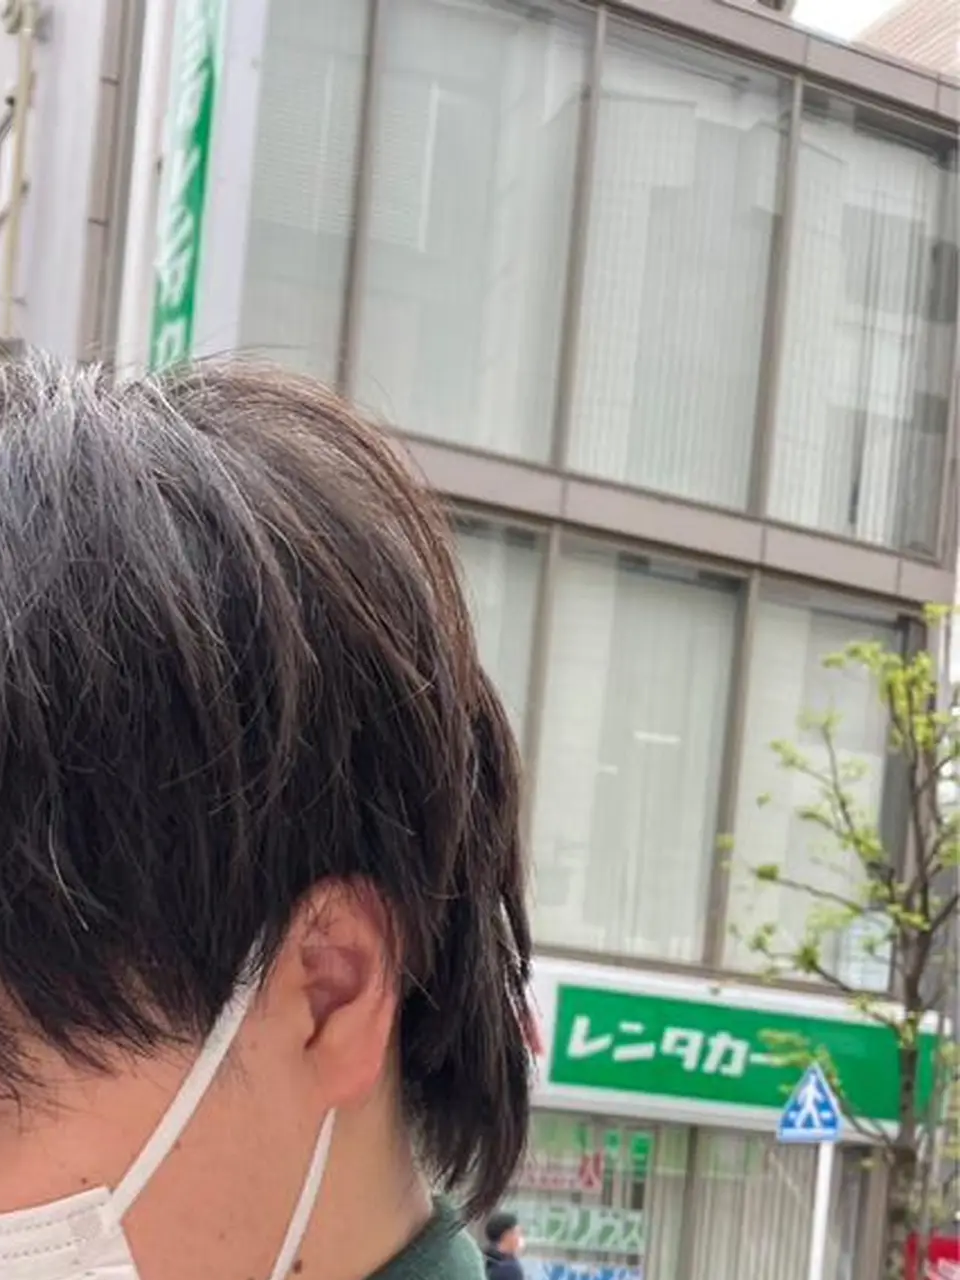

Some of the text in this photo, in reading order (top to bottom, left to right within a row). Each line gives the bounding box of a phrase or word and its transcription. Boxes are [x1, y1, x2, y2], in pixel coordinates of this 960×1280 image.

[567, 1014, 788, 1077] レンタカー
